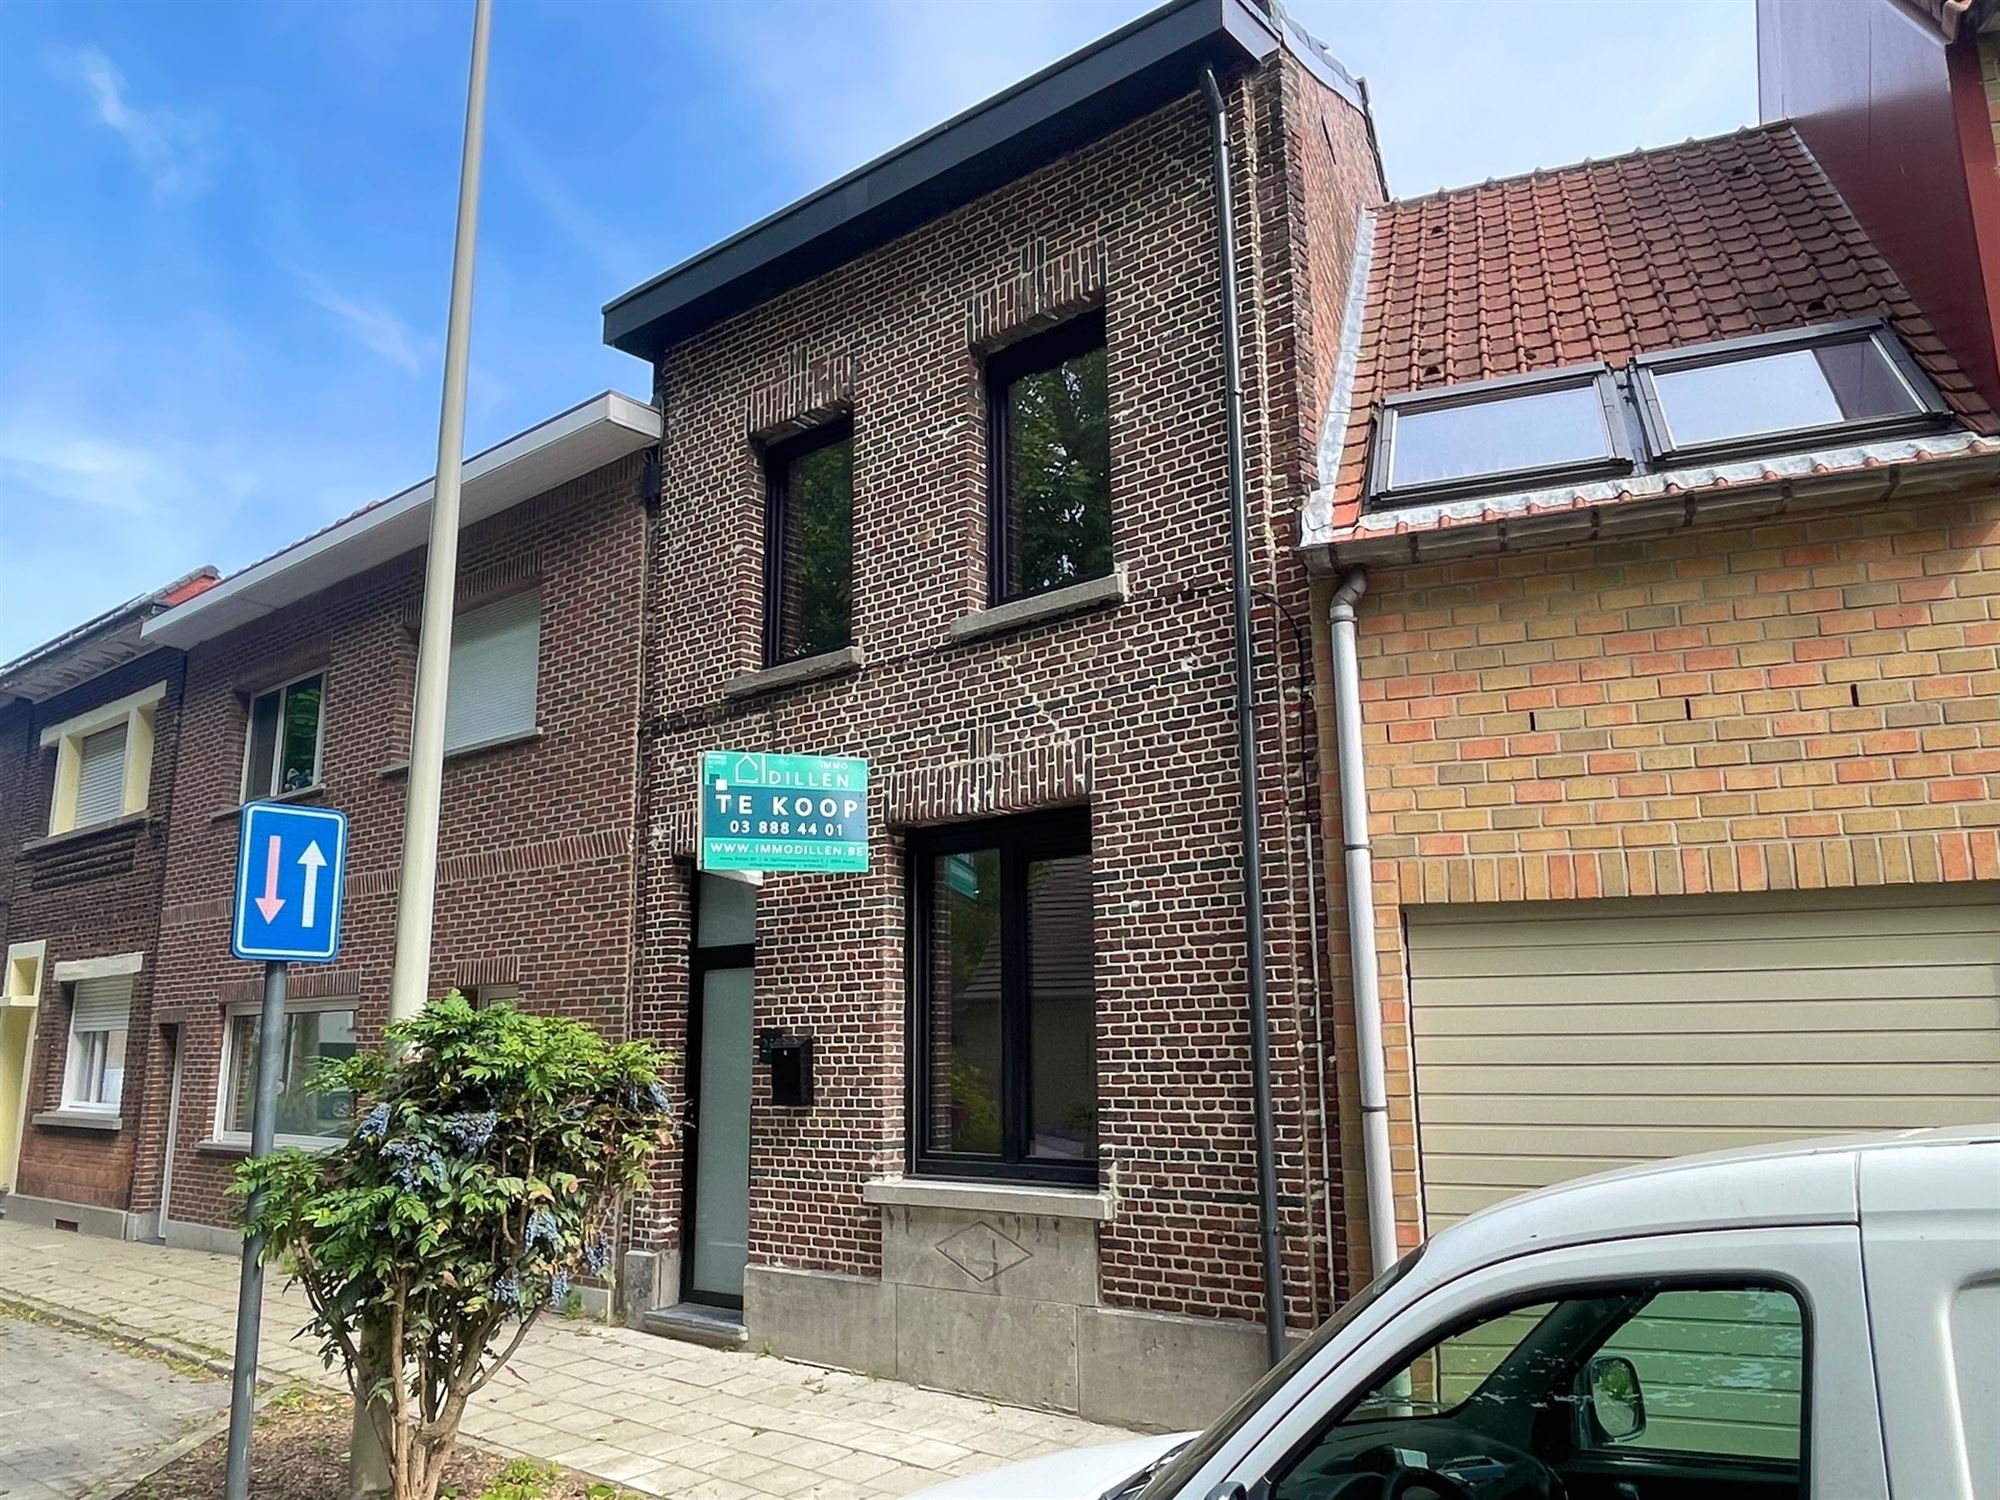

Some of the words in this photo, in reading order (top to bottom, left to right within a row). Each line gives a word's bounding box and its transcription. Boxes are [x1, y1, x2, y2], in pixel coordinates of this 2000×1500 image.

[820, 760, 849, 771] IMMO
[768, 769, 850, 789] DILLEN
[715, 794, 753, 815] TE
[772, 796, 859, 819] KOOP
[729, 820, 750, 834] 03
[758, 820, 790, 836] 888
[797, 822, 818, 837] 44
[824, 823, 844, 837] 01
[710, 842, 866, 857] WWW.IMMODILLEN.BE
